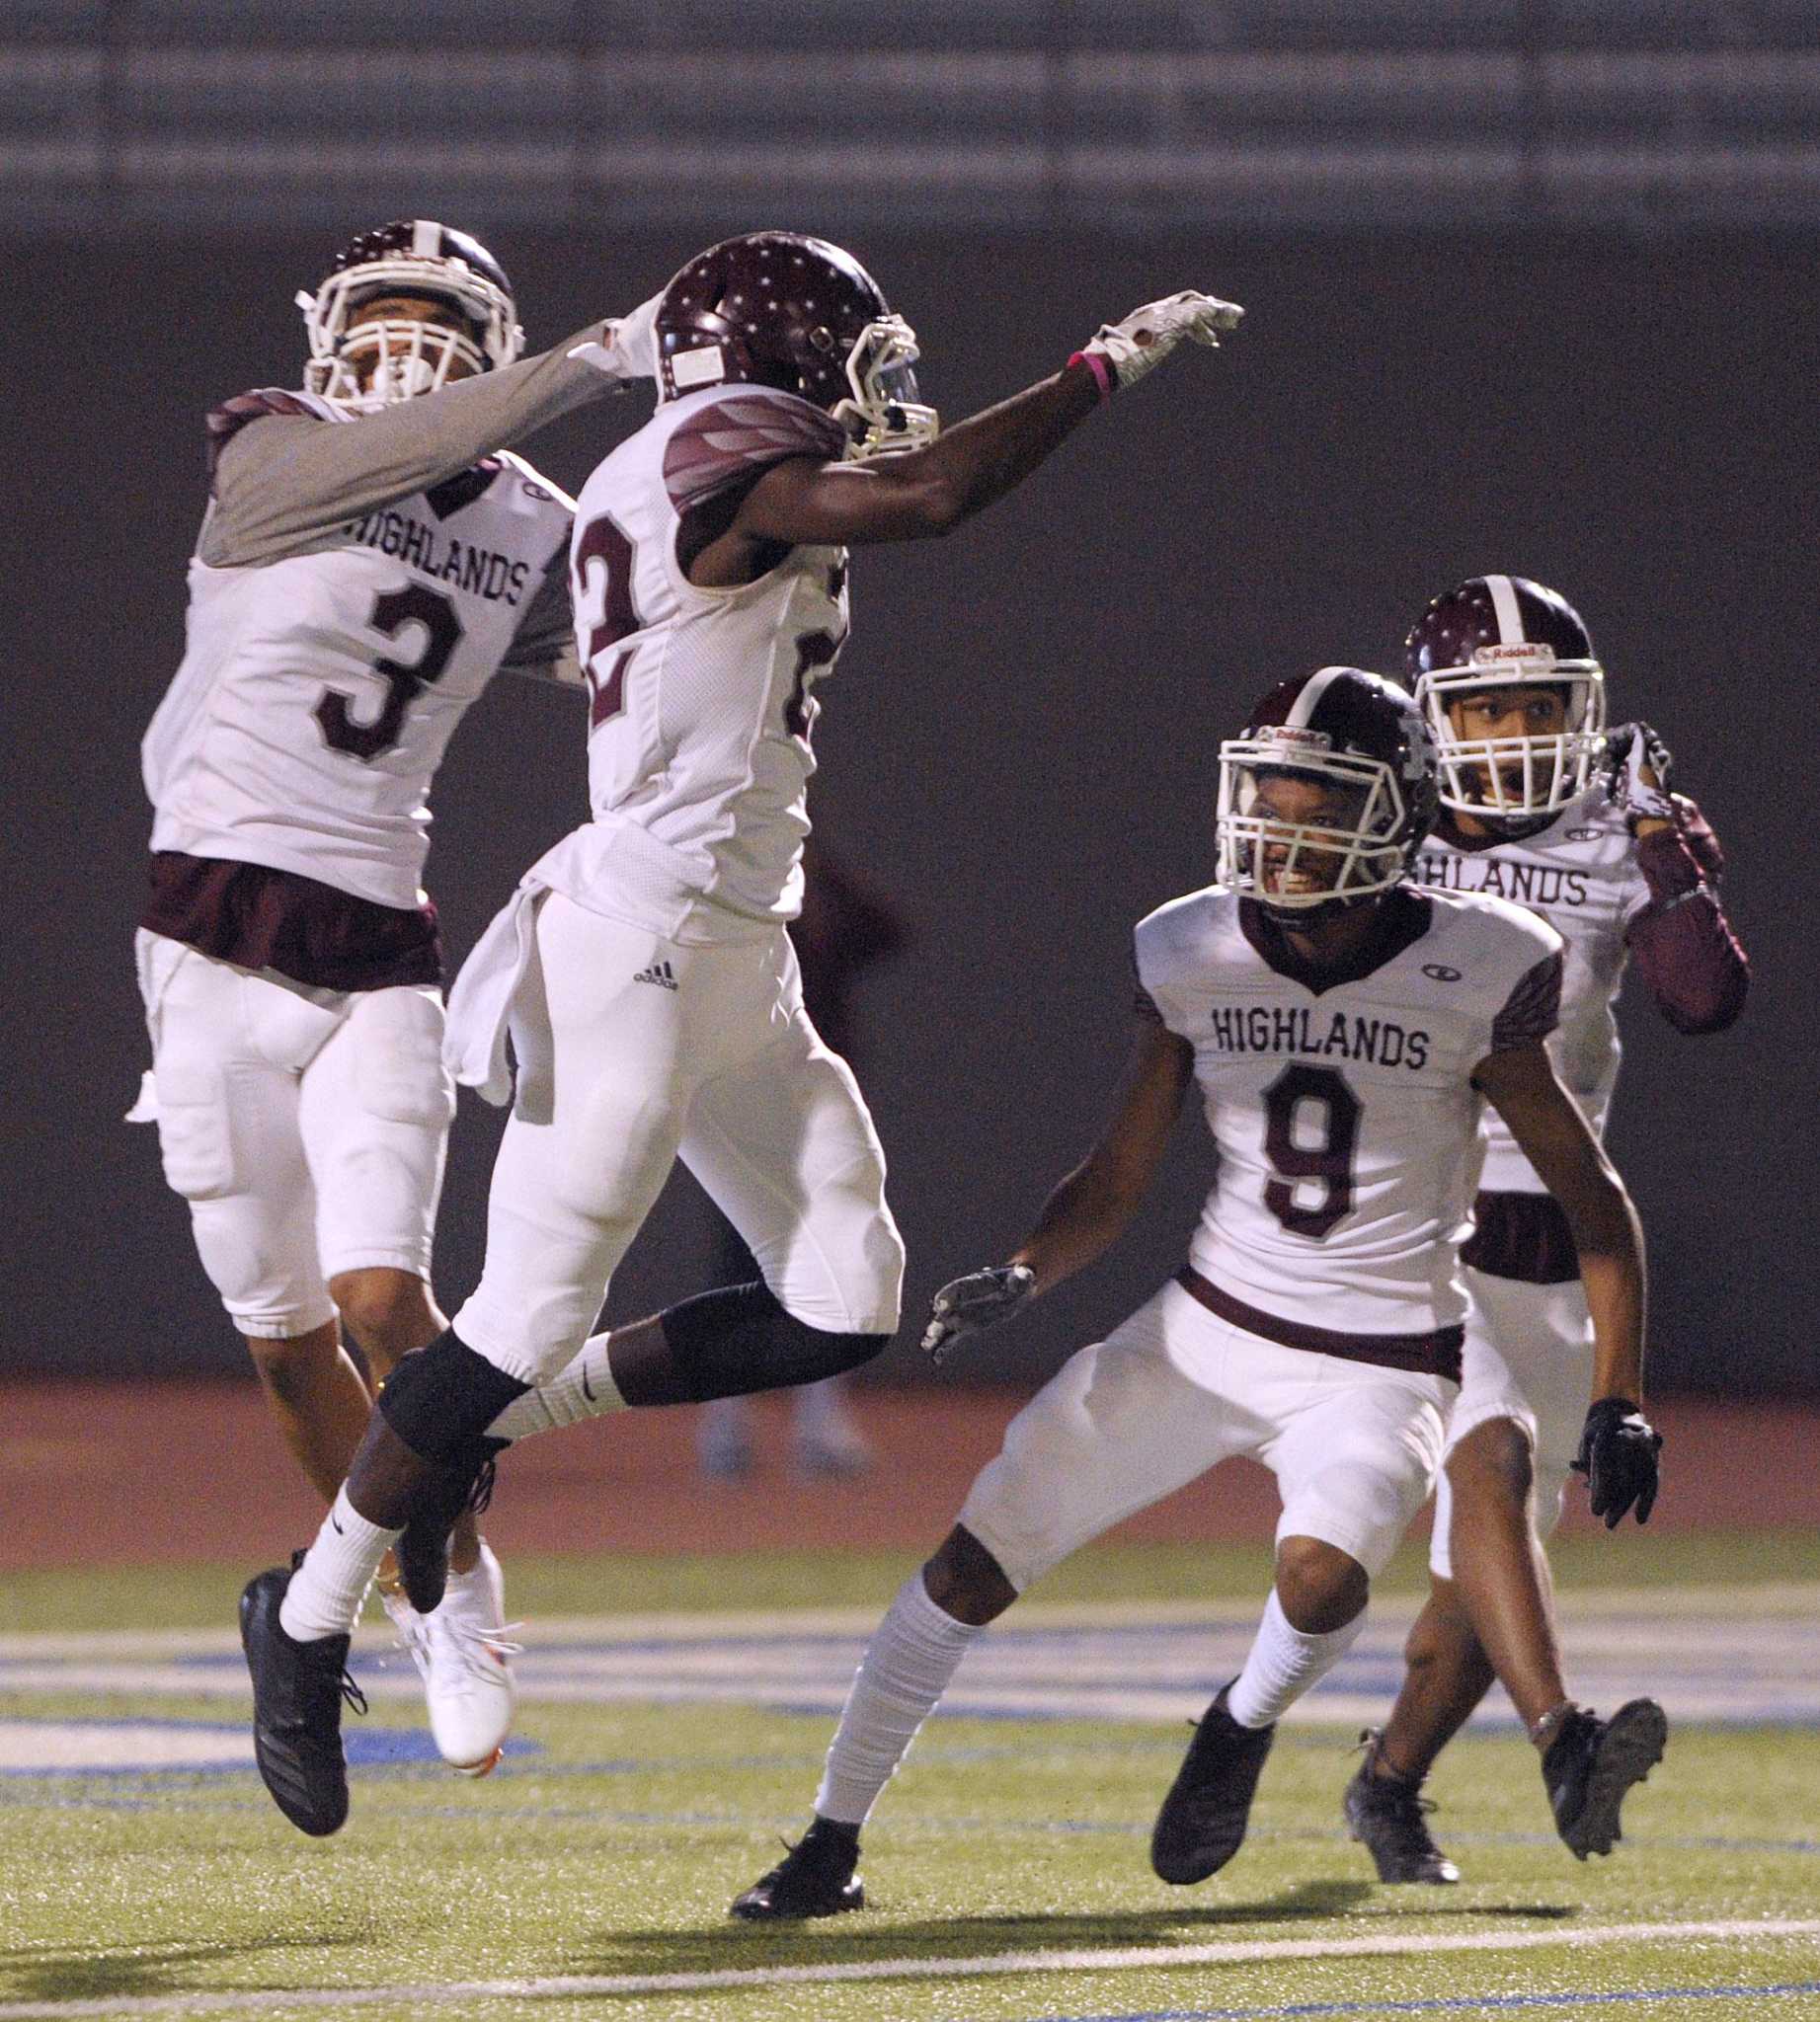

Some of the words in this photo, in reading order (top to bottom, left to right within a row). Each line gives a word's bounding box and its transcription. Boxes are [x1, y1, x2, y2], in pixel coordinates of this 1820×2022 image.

[313, 577, 464, 763] 3
[1412, 855, 1591, 906] HLANDS
[633, 972, 678, 990] adidas
[1212, 1007, 1431, 1069] HIGHLANDS
[1261, 1061, 1364, 1241] 9
